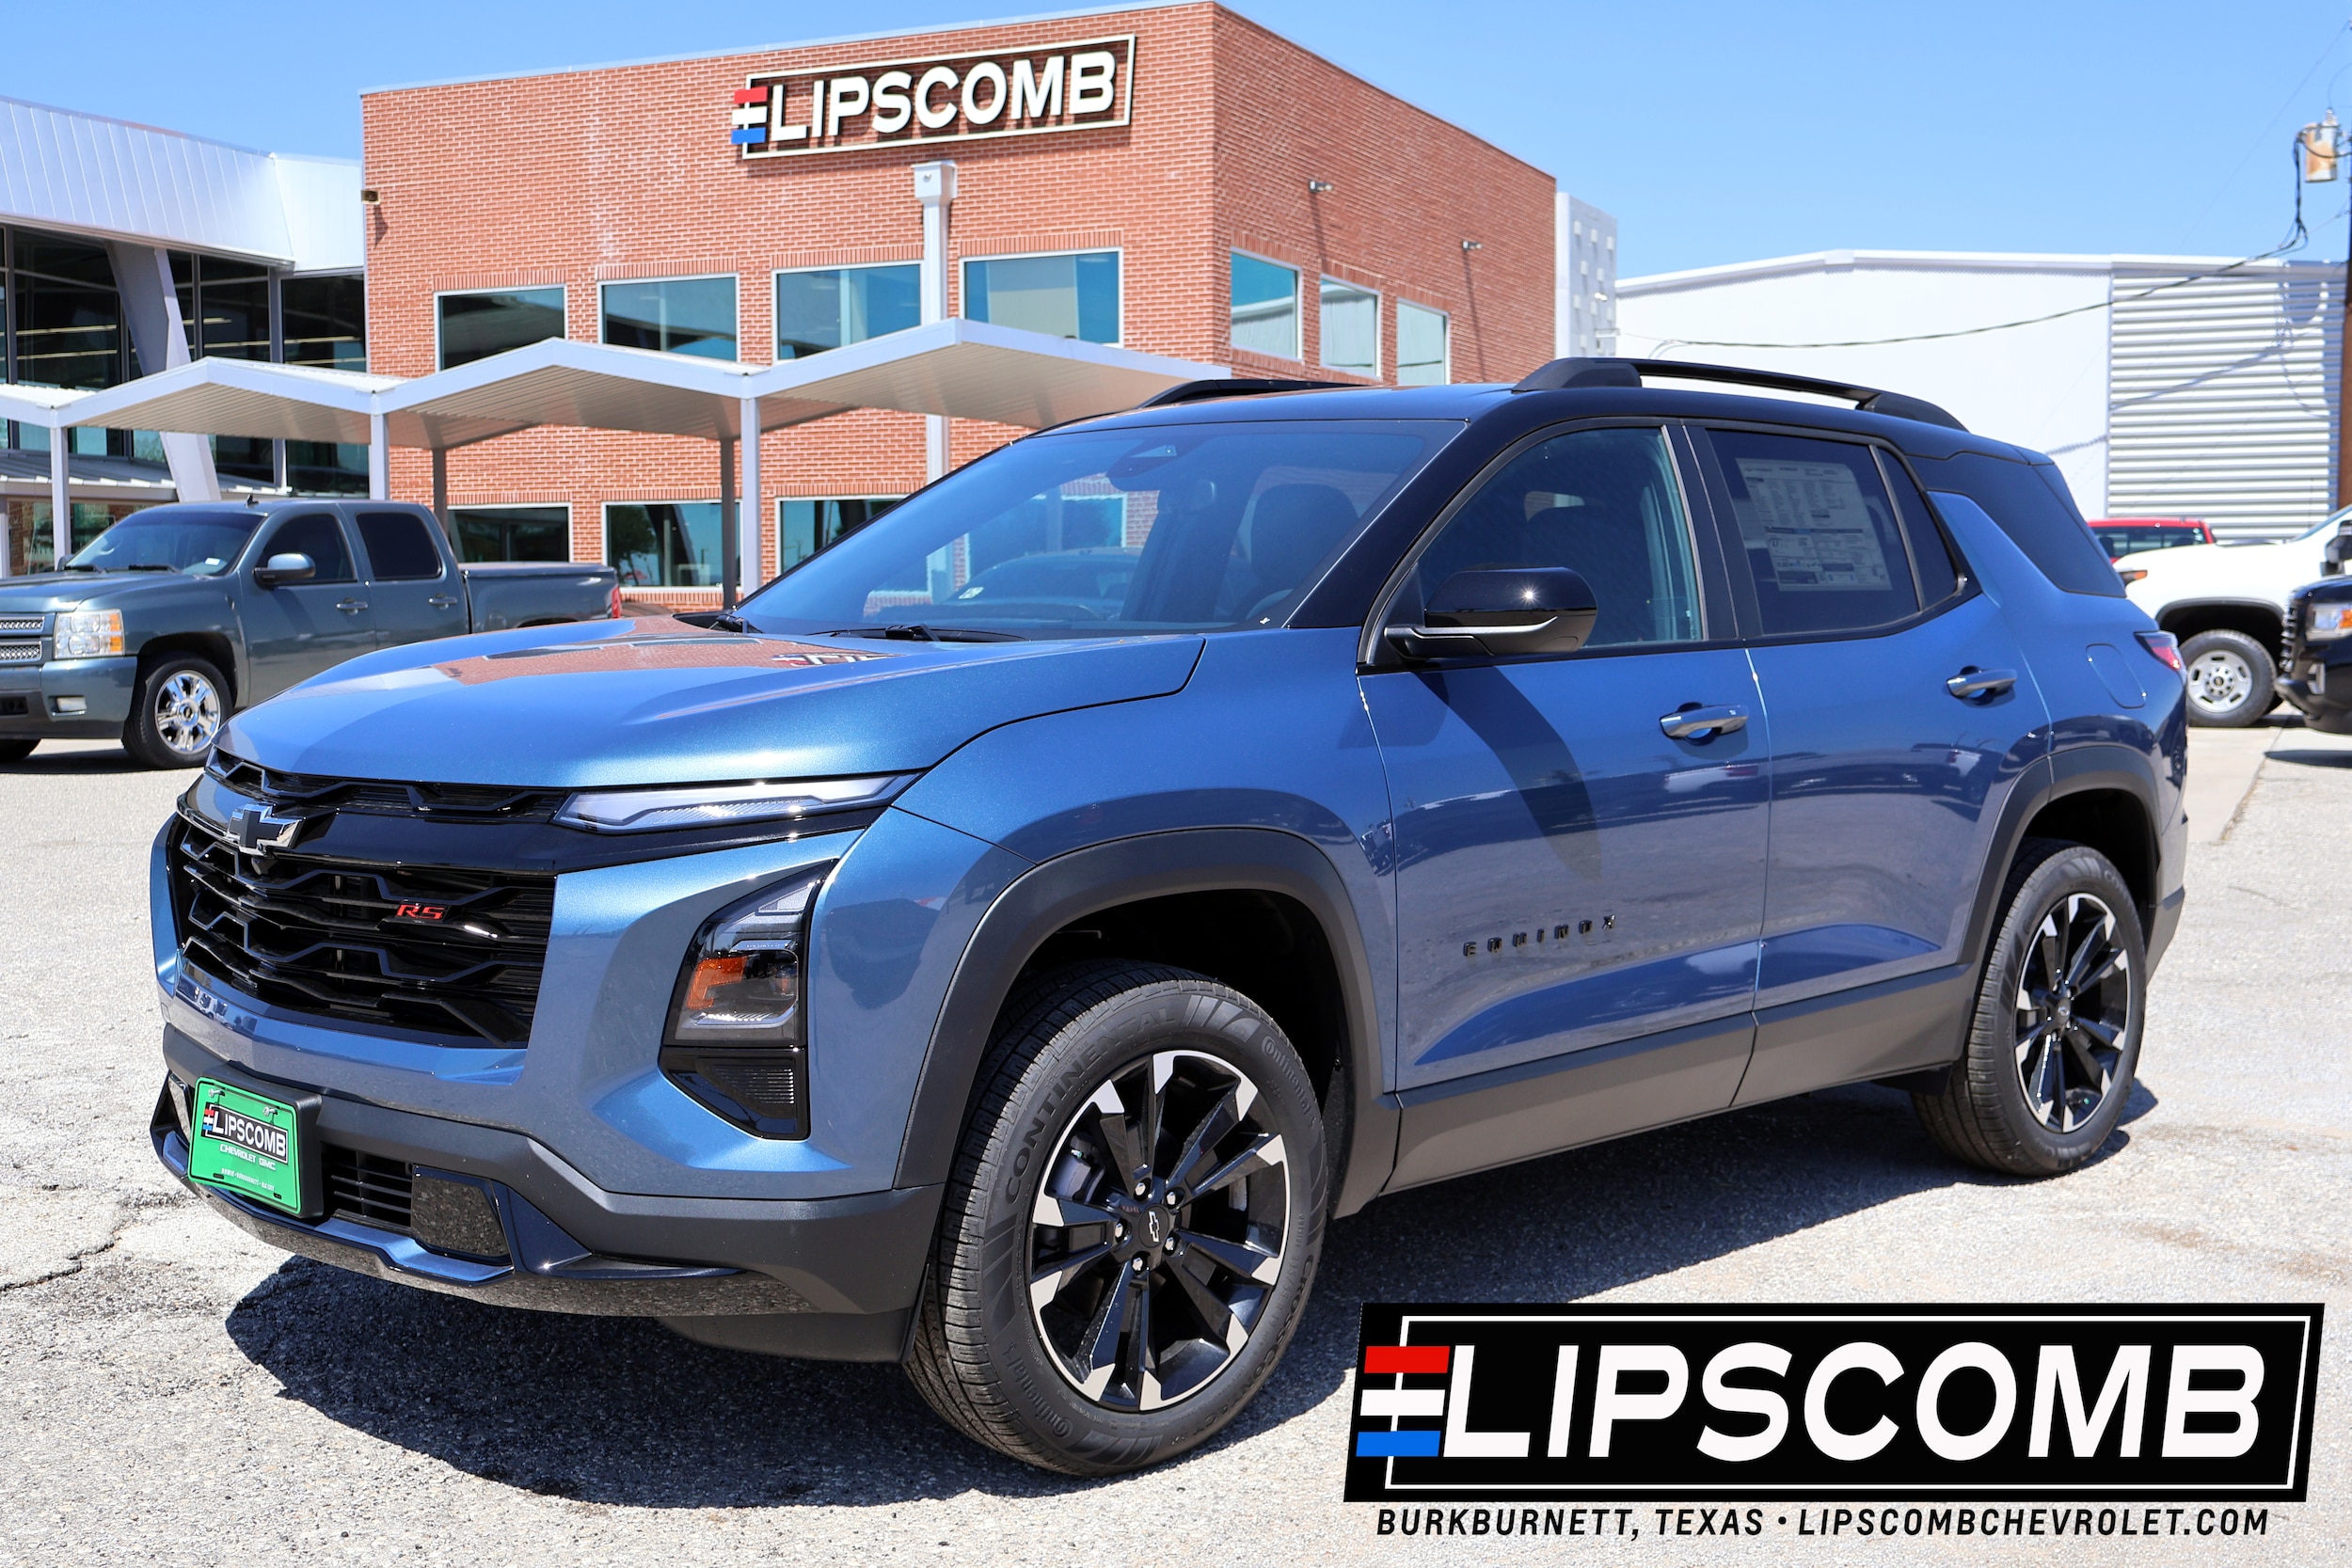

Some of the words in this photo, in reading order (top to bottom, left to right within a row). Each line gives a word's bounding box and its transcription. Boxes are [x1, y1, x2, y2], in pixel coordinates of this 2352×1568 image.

[770, 50, 1117, 141] LIPSCOMB
[396, 904, 446, 920] RS
[1463, 913, 1616, 958] EQUINOX
[1005, 1006, 1176, 1205] CONTINENTAL
[212, 1110, 286, 1157] LIPSCOMB
[219, 1144, 256, 1164] CHEVROLET
[259, 1157, 277, 1171] GMC
